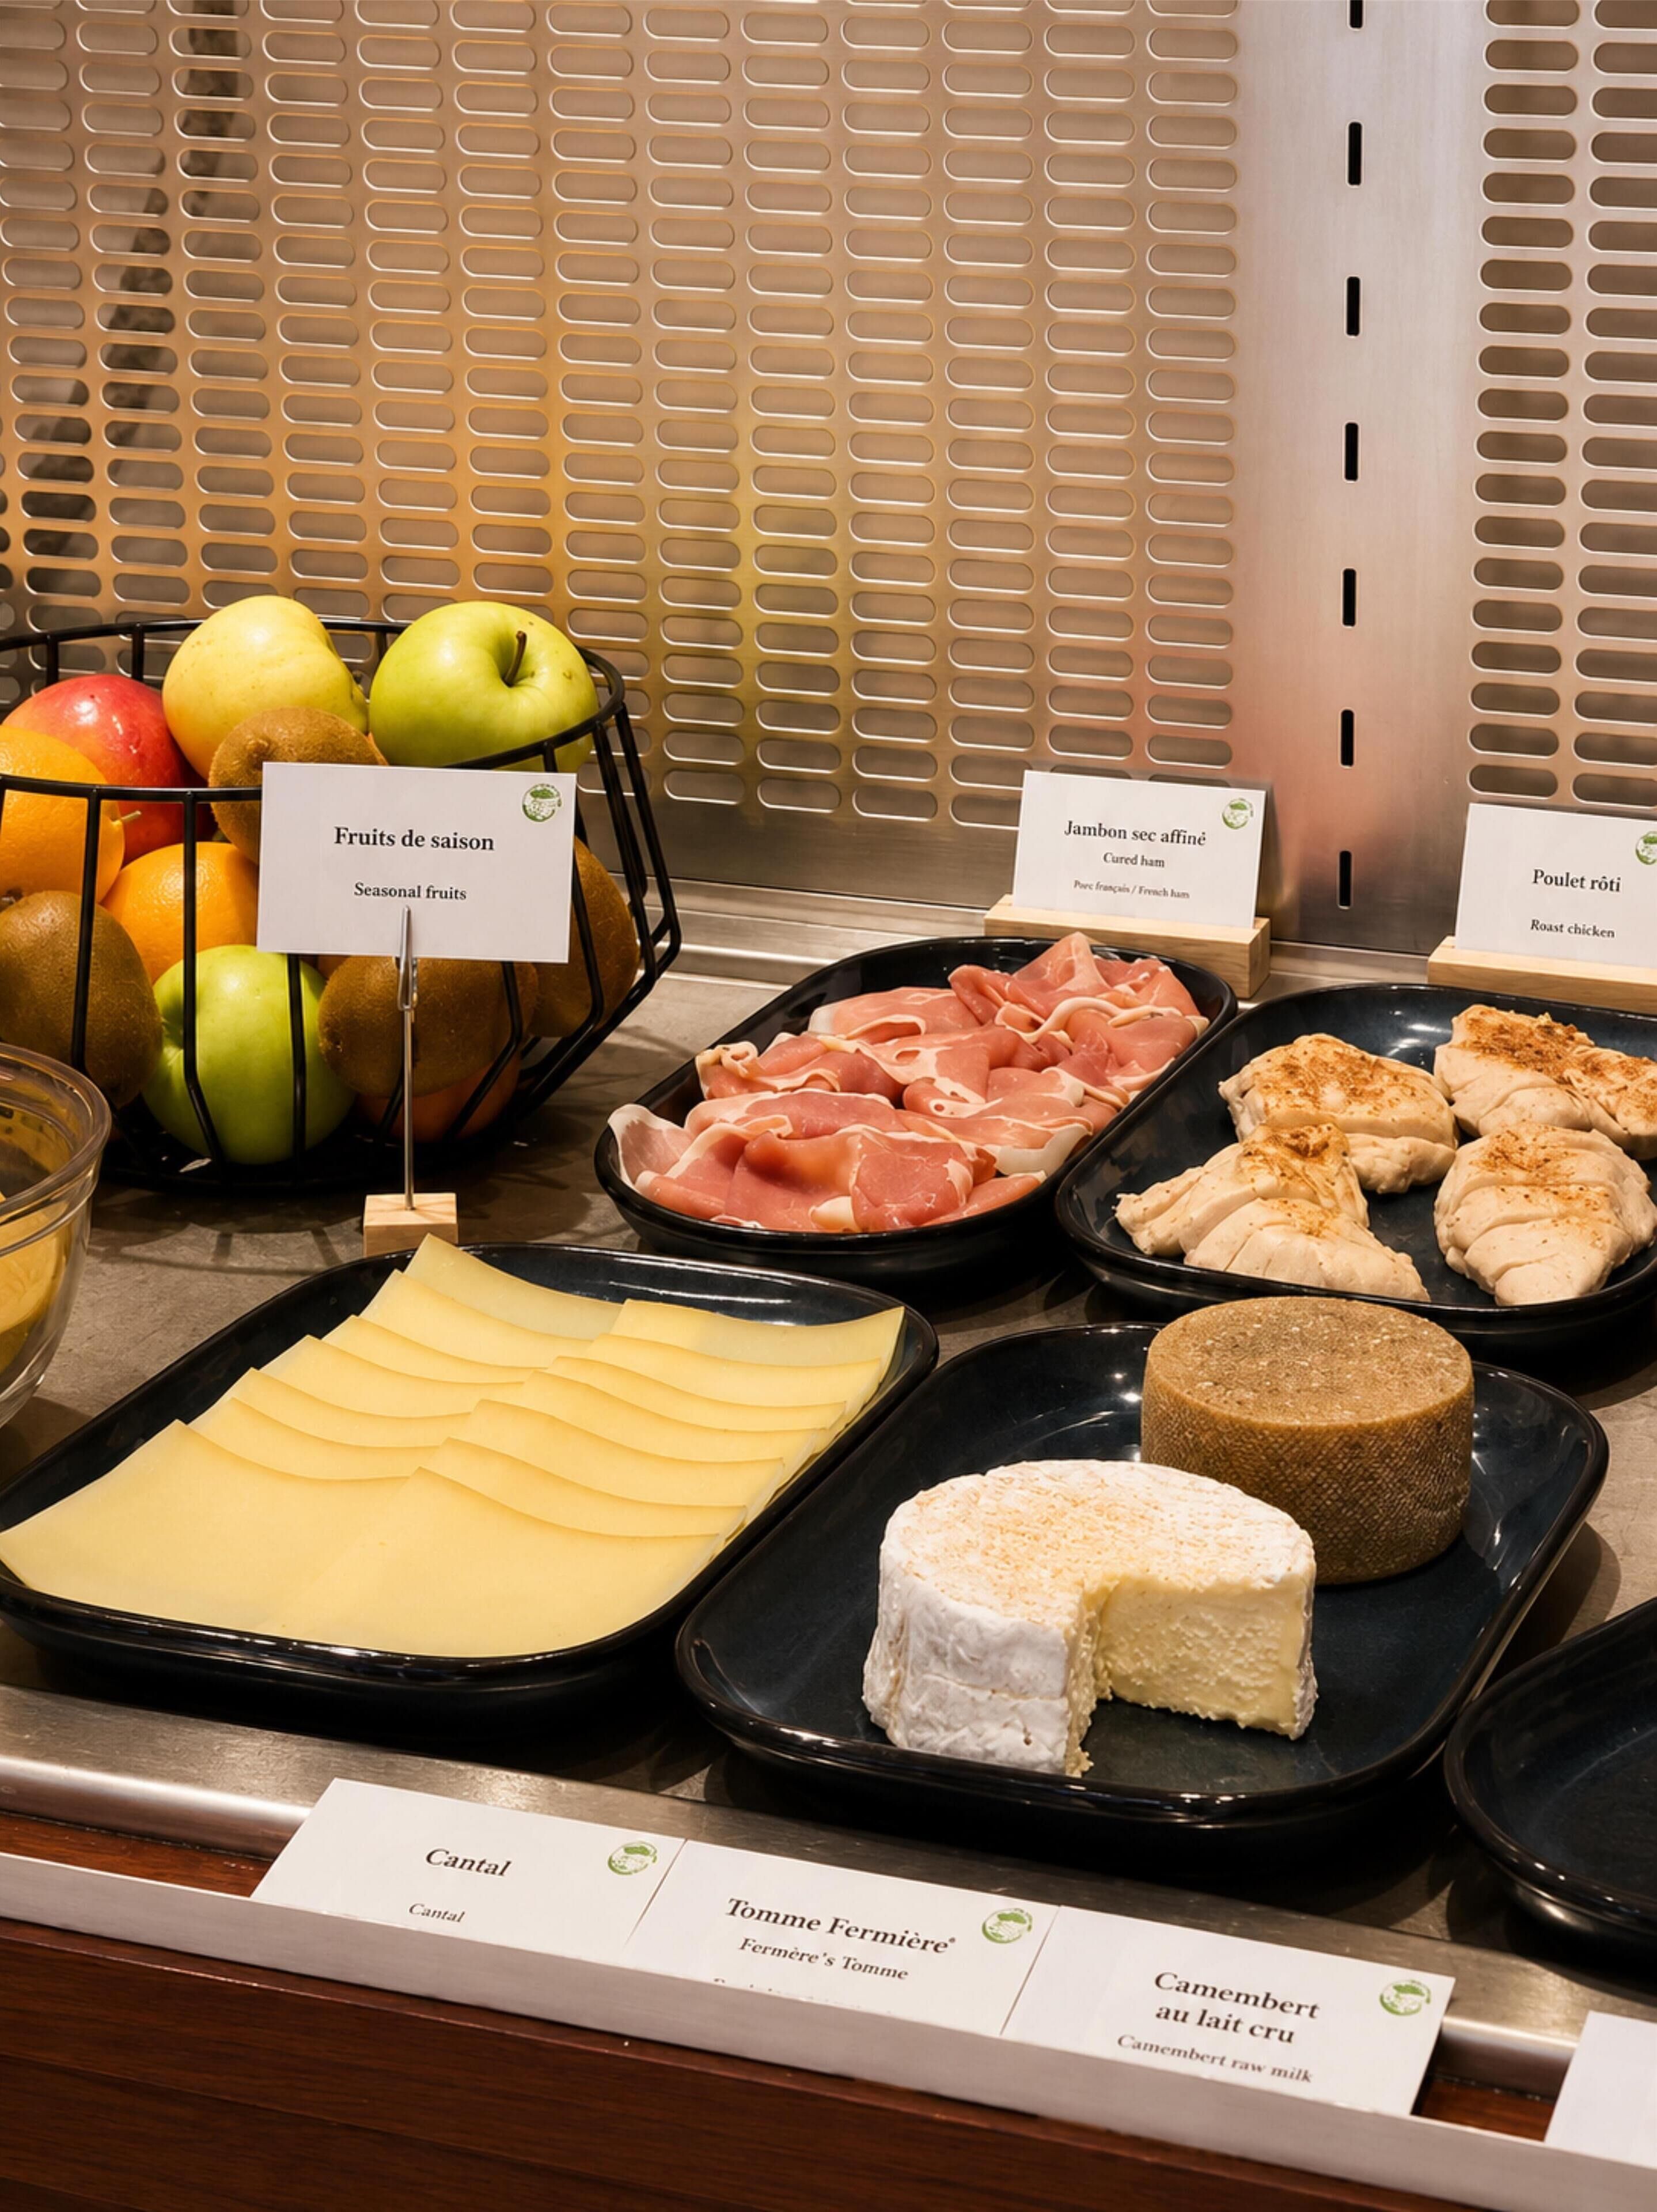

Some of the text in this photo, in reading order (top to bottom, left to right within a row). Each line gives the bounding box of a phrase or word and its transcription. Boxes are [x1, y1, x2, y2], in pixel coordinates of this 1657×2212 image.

[334, 826, 494, 851] Fruits de saison
[1064, 820, 1127, 839] Jambon
[1131, 831, 1157, 842] sec
[1103, 852, 1165, 868] Cured ham
[354, 882, 467, 900] Seasonal fruits
[1073, 880, 1094, 891] Porc
[1131, 884, 1137, 895] /
[1138, 885, 1169, 897] French
[1170, 888, 1190, 899] ham
[1532, 869, 1622, 892] Poulet rôti
[1530, 919, 1616, 939] Roast chicken
[426, 1849, 513, 1877] Cantal
[408, 1903, 465, 1923] Cantal
[727, 1898, 821, 1931] Tomme
[842, 1956, 909, 1980] Tomme
[1154, 1972, 1319, 2020] Camembert
[1155, 2007, 1295, 2044] au lait cru
[1117, 2035, 1312, 2083] Camembert raw milk
